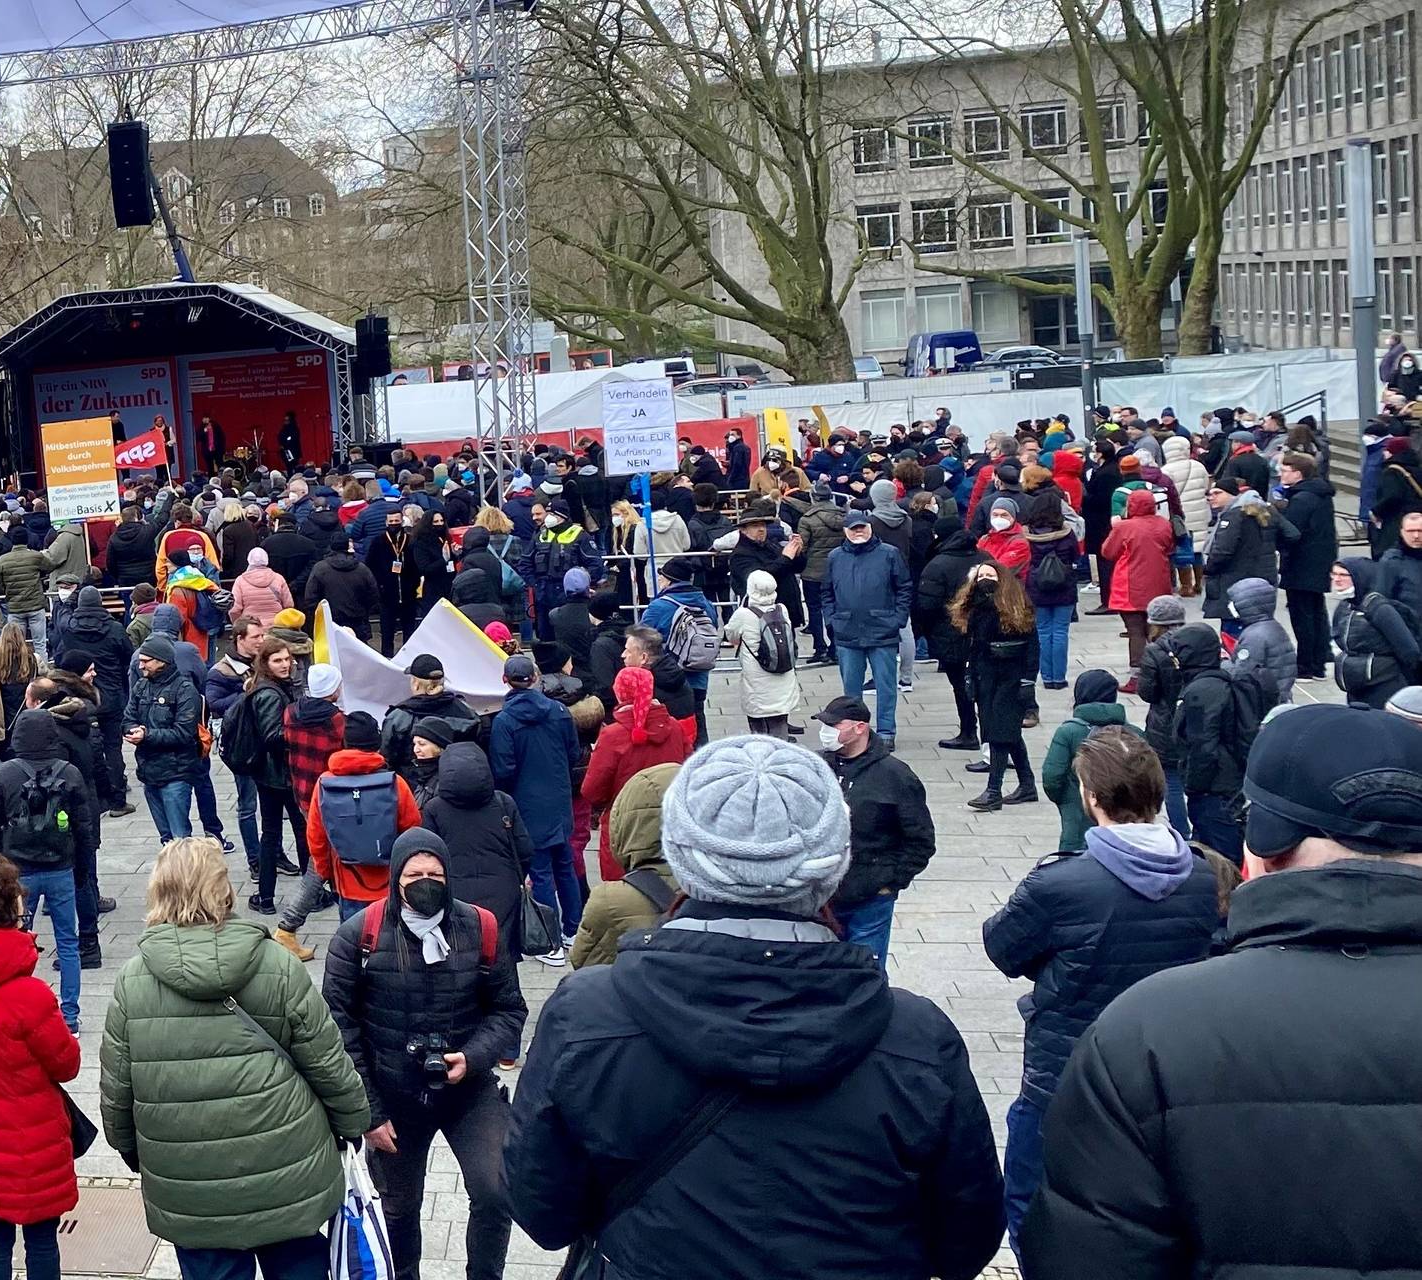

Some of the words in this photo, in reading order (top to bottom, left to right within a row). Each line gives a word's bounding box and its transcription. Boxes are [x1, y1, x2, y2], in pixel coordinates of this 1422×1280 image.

[296, 354, 323, 367] SPD
[141, 367, 167, 379] SPD
[39, 382, 59, 393] Für
[61, 380, 78, 391] ein
[80, 378, 108, 389] NRW
[608, 388, 668, 400] Verhandeln
[42, 396, 74, 414] der
[80, 388, 169, 412] Zukunft.
[631, 408, 647, 418] JA
[45, 437, 112, 452] Mitbestimmung
[609, 436, 625, 445] 100
[650, 432, 672, 442] EUR
[67, 451, 92, 461] durch
[614, 447, 662, 458] Aufrüstung
[50, 462, 111, 474] Volksbegehren
[627, 459, 650, 468] NEIN
[63, 503, 103, 516] dieBasis
